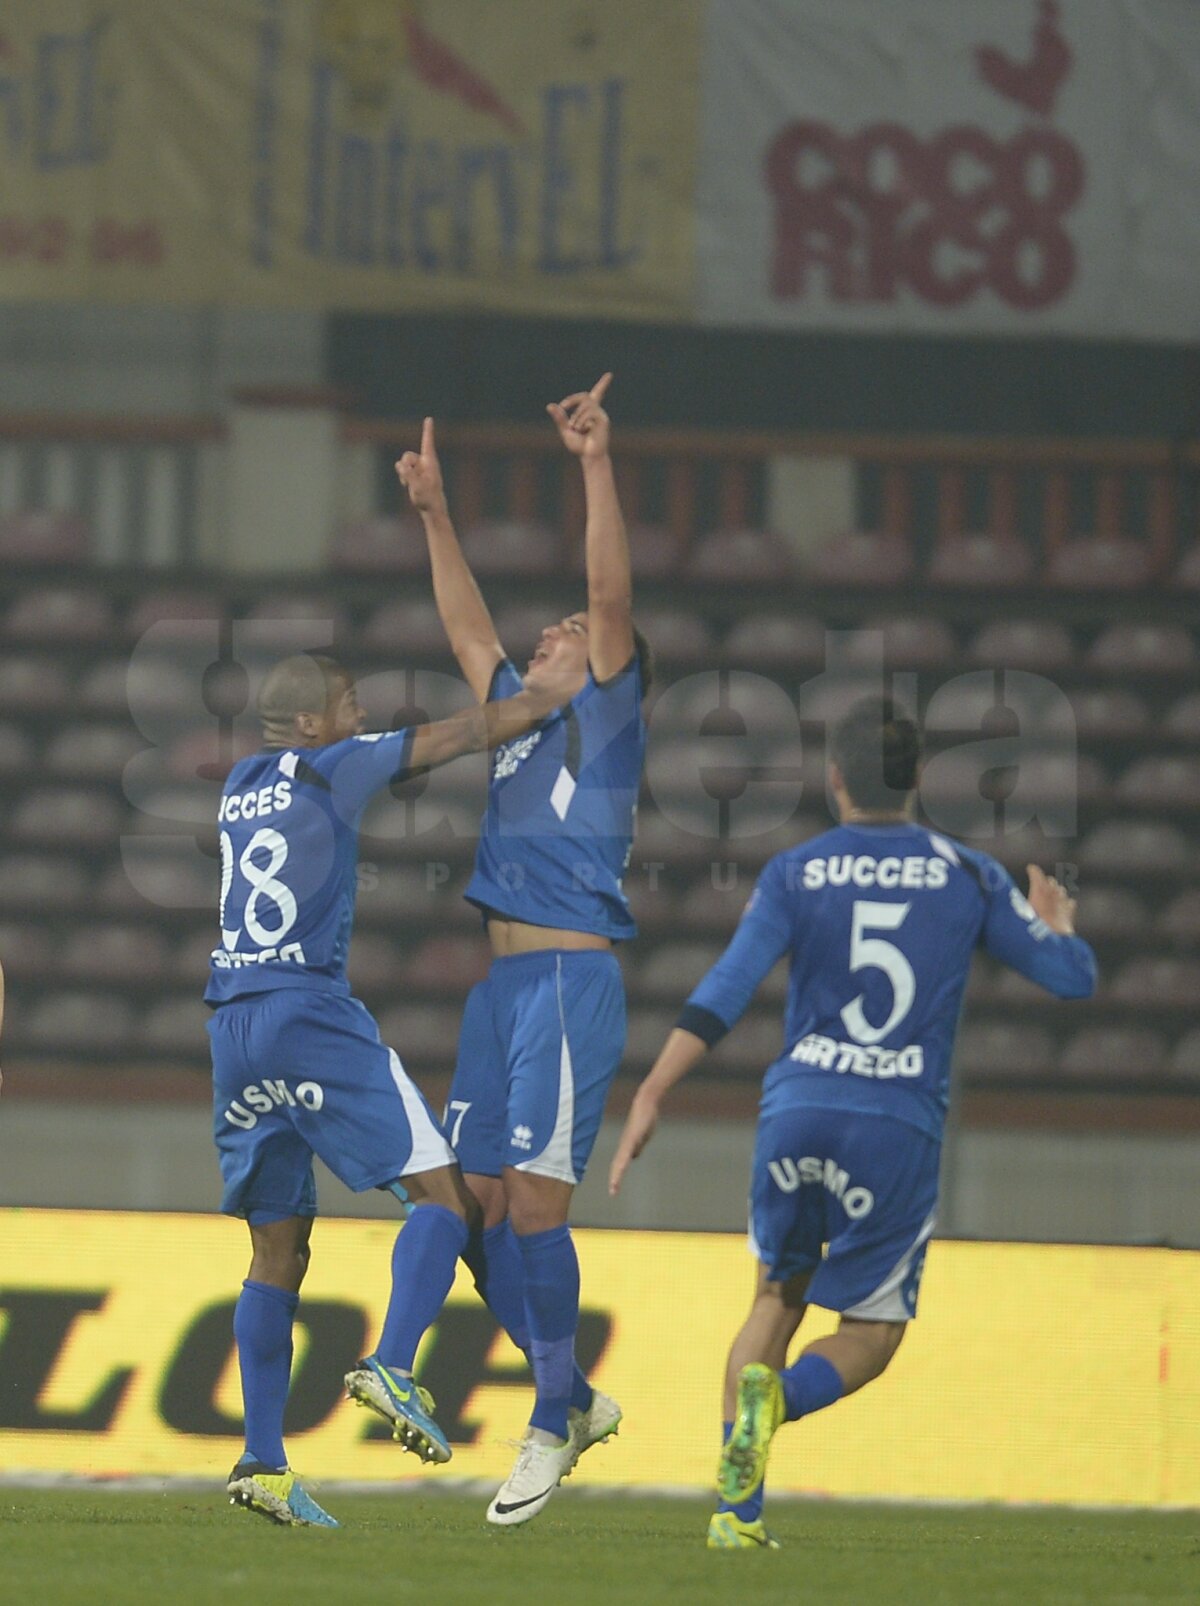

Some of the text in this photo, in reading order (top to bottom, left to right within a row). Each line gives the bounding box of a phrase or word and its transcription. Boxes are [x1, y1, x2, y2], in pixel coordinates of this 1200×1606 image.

[763, 117, 1085, 210] COCO
[772, 199, 1077, 312] RICO
[803, 855, 949, 890] SUCCES
[839, 899, 917, 1045] 5
[789, 1033, 924, 1079] ARTEGO
[224, 1078, 325, 1131] USMO
[767, 1156, 875, 1220] USMO
